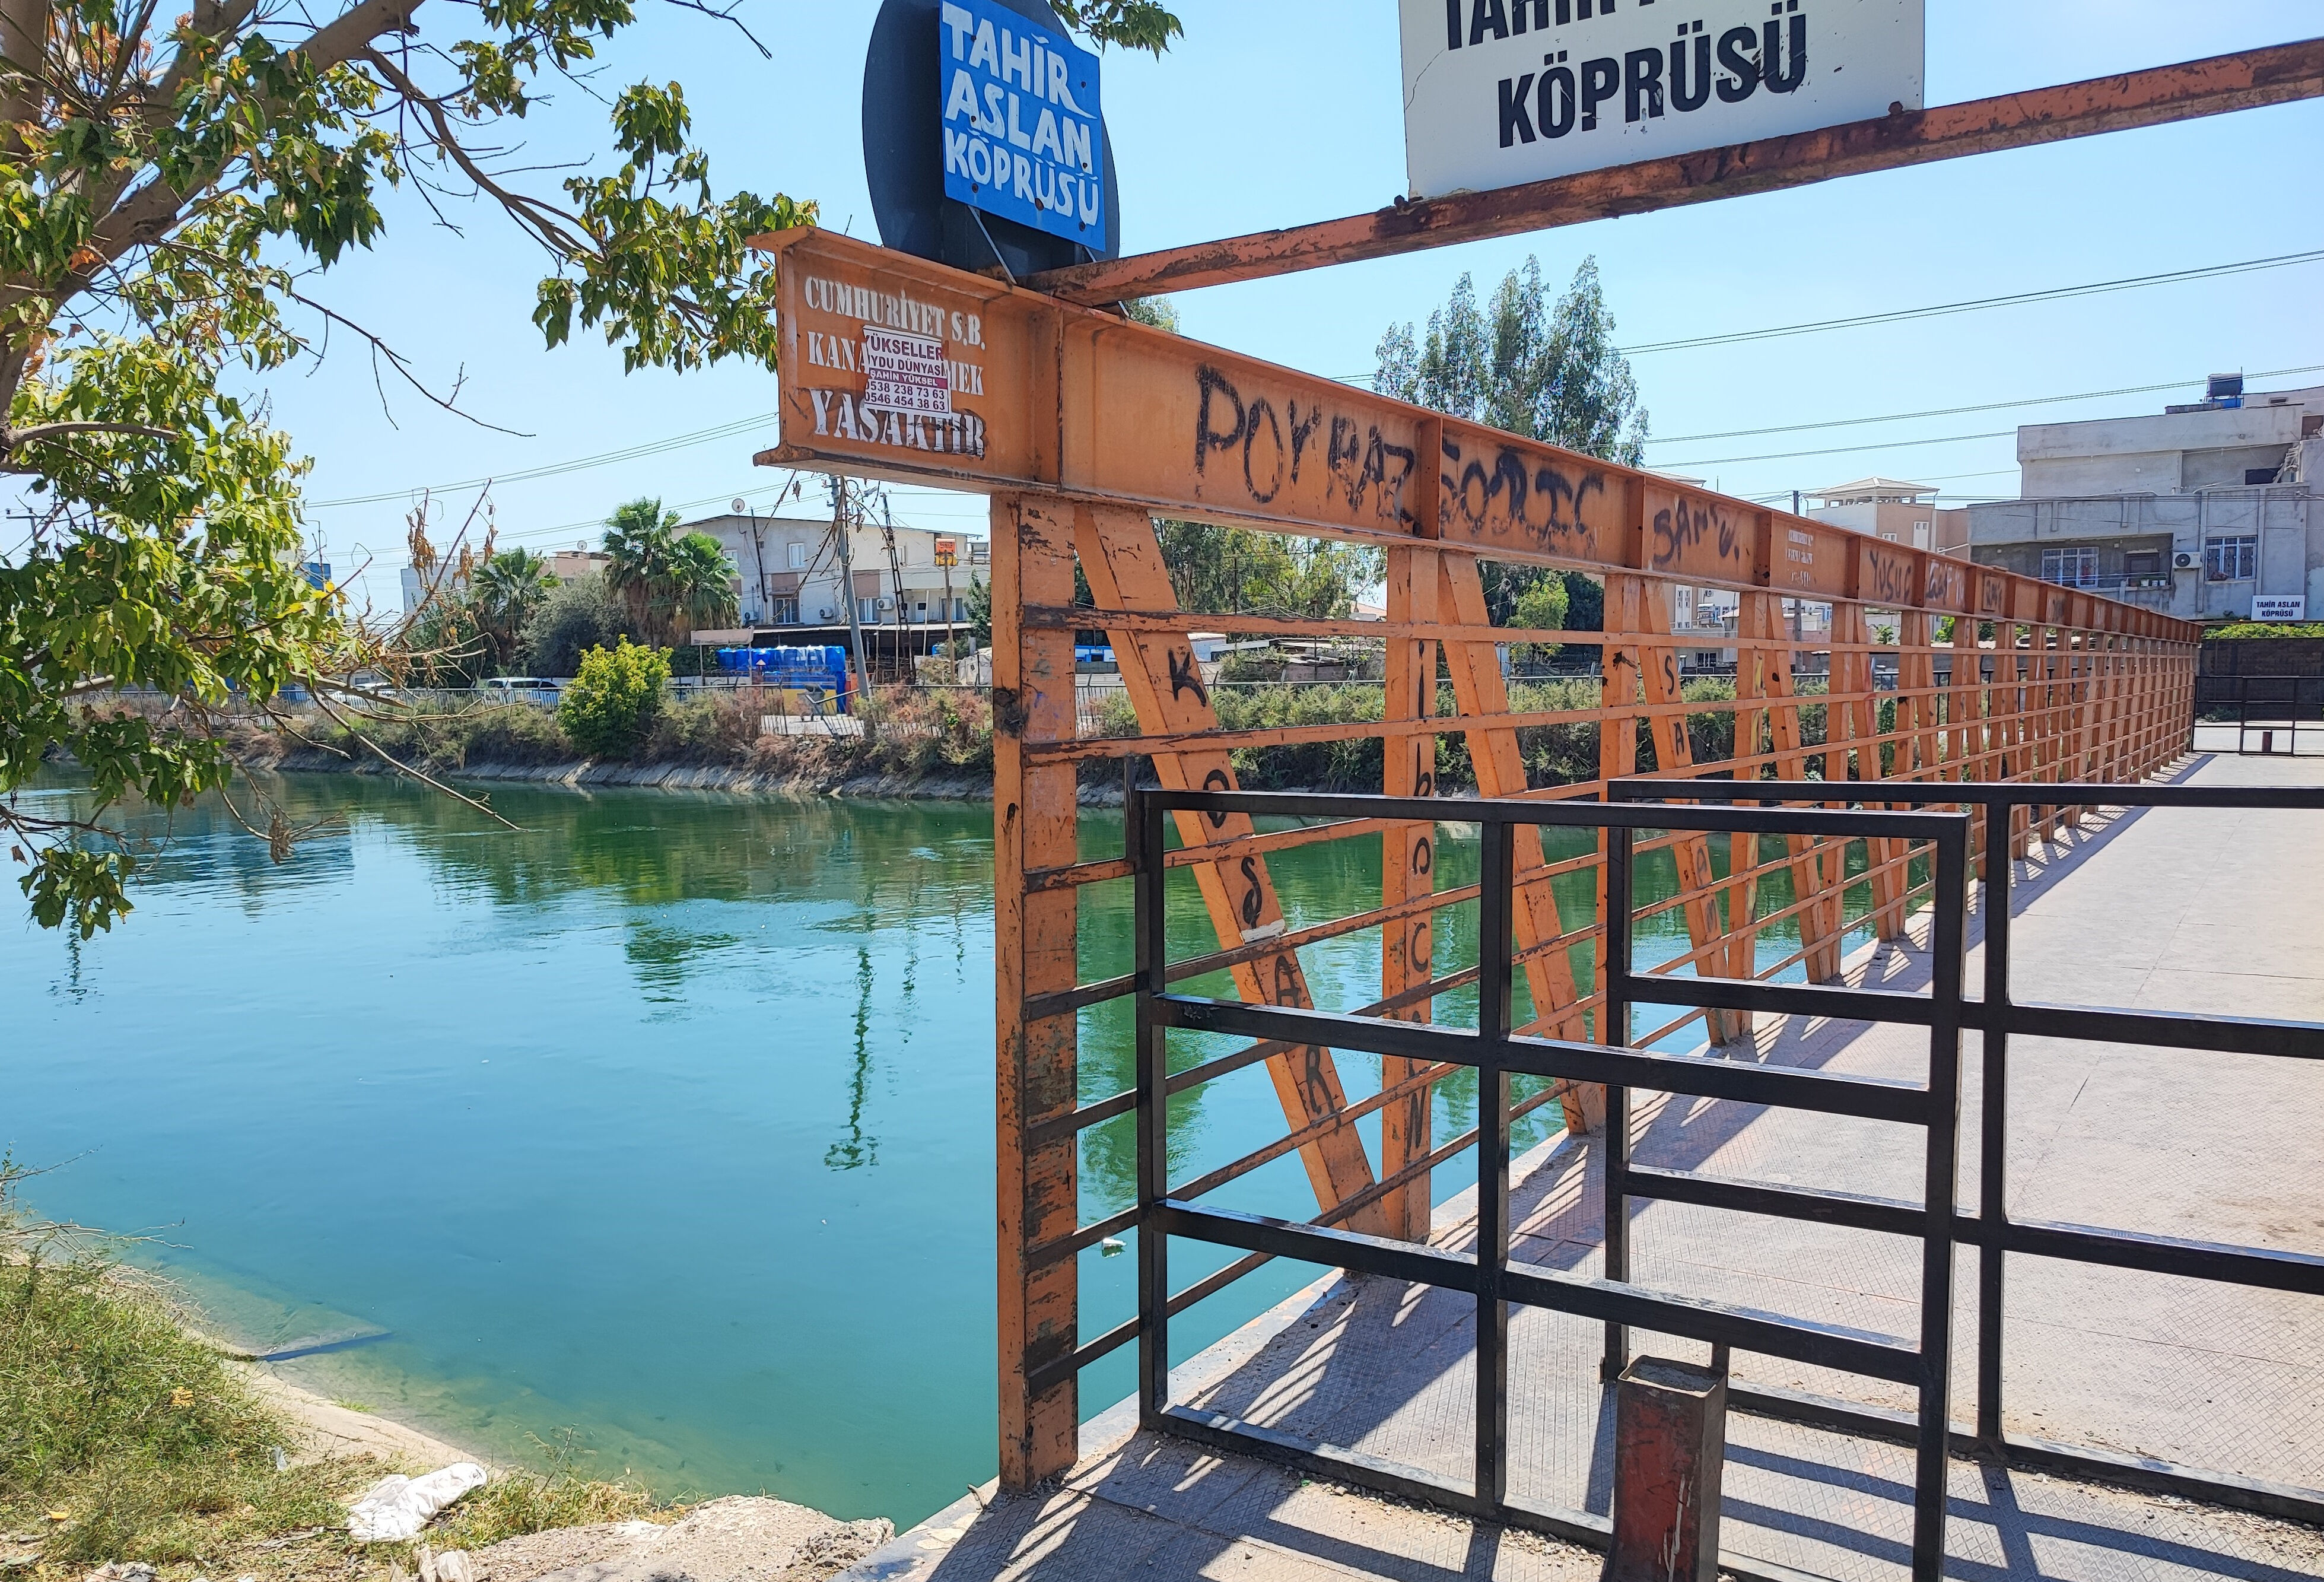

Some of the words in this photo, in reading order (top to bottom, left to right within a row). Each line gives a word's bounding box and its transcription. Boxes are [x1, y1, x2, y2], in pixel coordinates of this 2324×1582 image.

[942, 1, 1098, 119] TAHİR
[1498, 0, 1807, 148] KÖPRÜSÜ
[945, 68, 1093, 174] ASLAN
[945, 127, 1099, 226] KÖPRÜSÜ
[805, 276, 945, 338] CUMHURİYET
[807, 331, 870, 374] KANA
[868, 355, 894, 369] YDU
[894, 384, 913, 396] 238
[917, 387, 929, 398] 73
[933, 389, 945, 399] 63
[902, 374, 938, 386] YÜKSEL
[894, 395, 914, 407] 454
[917, 398, 930, 409] 38
[933, 400, 945, 411] 63
[2256, 600, 2275, 608] TAHİR
[2262, 609, 2294, 617] KÖPRÜSÜ
